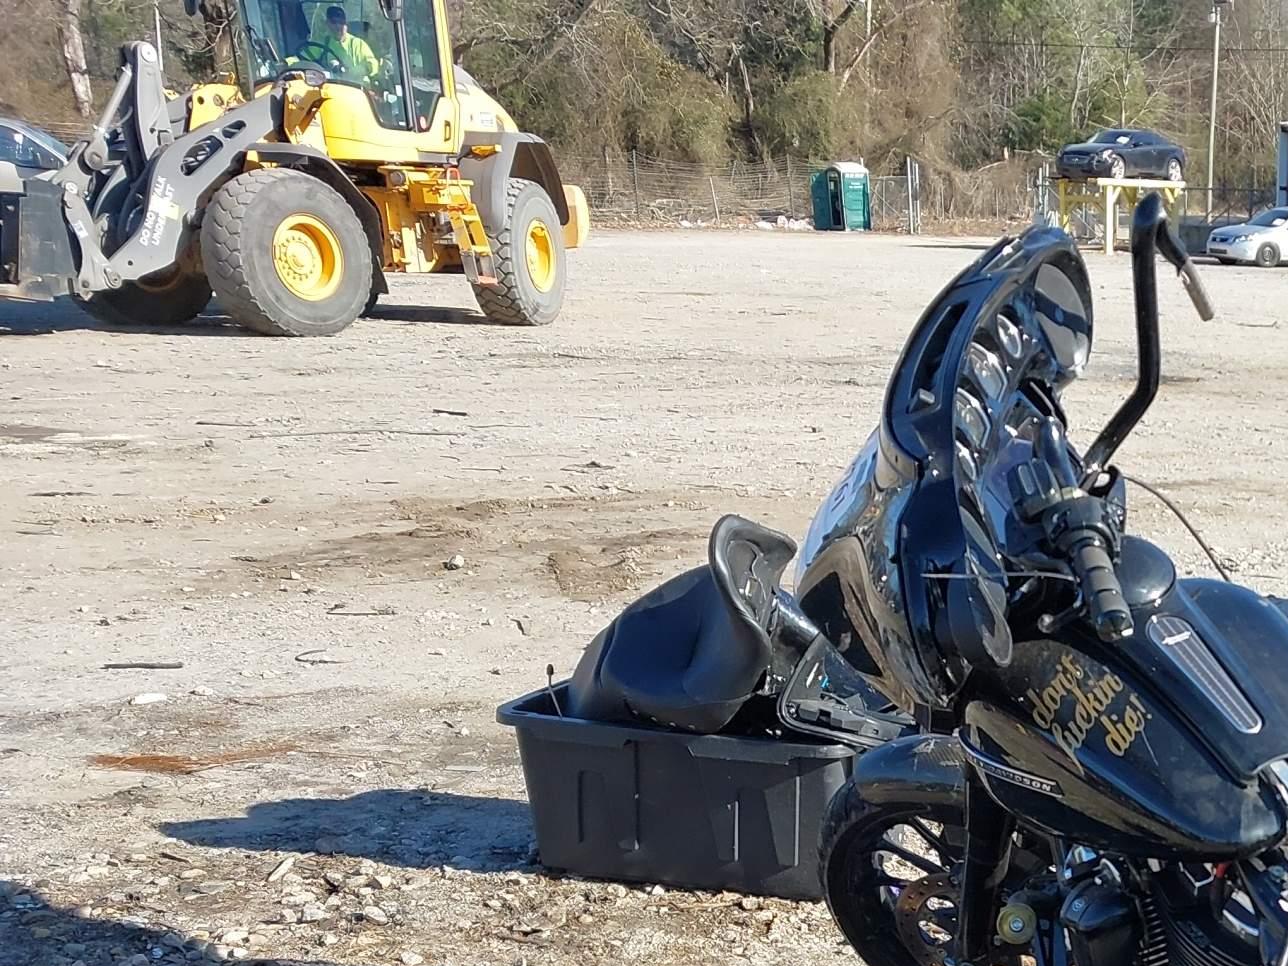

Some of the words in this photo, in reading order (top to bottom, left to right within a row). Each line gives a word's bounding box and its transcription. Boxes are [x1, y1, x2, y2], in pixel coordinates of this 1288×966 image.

[139, 229, 150, 246] DO
[1027, 652, 1083, 728] don't
[1100, 693, 1152, 757] die!
